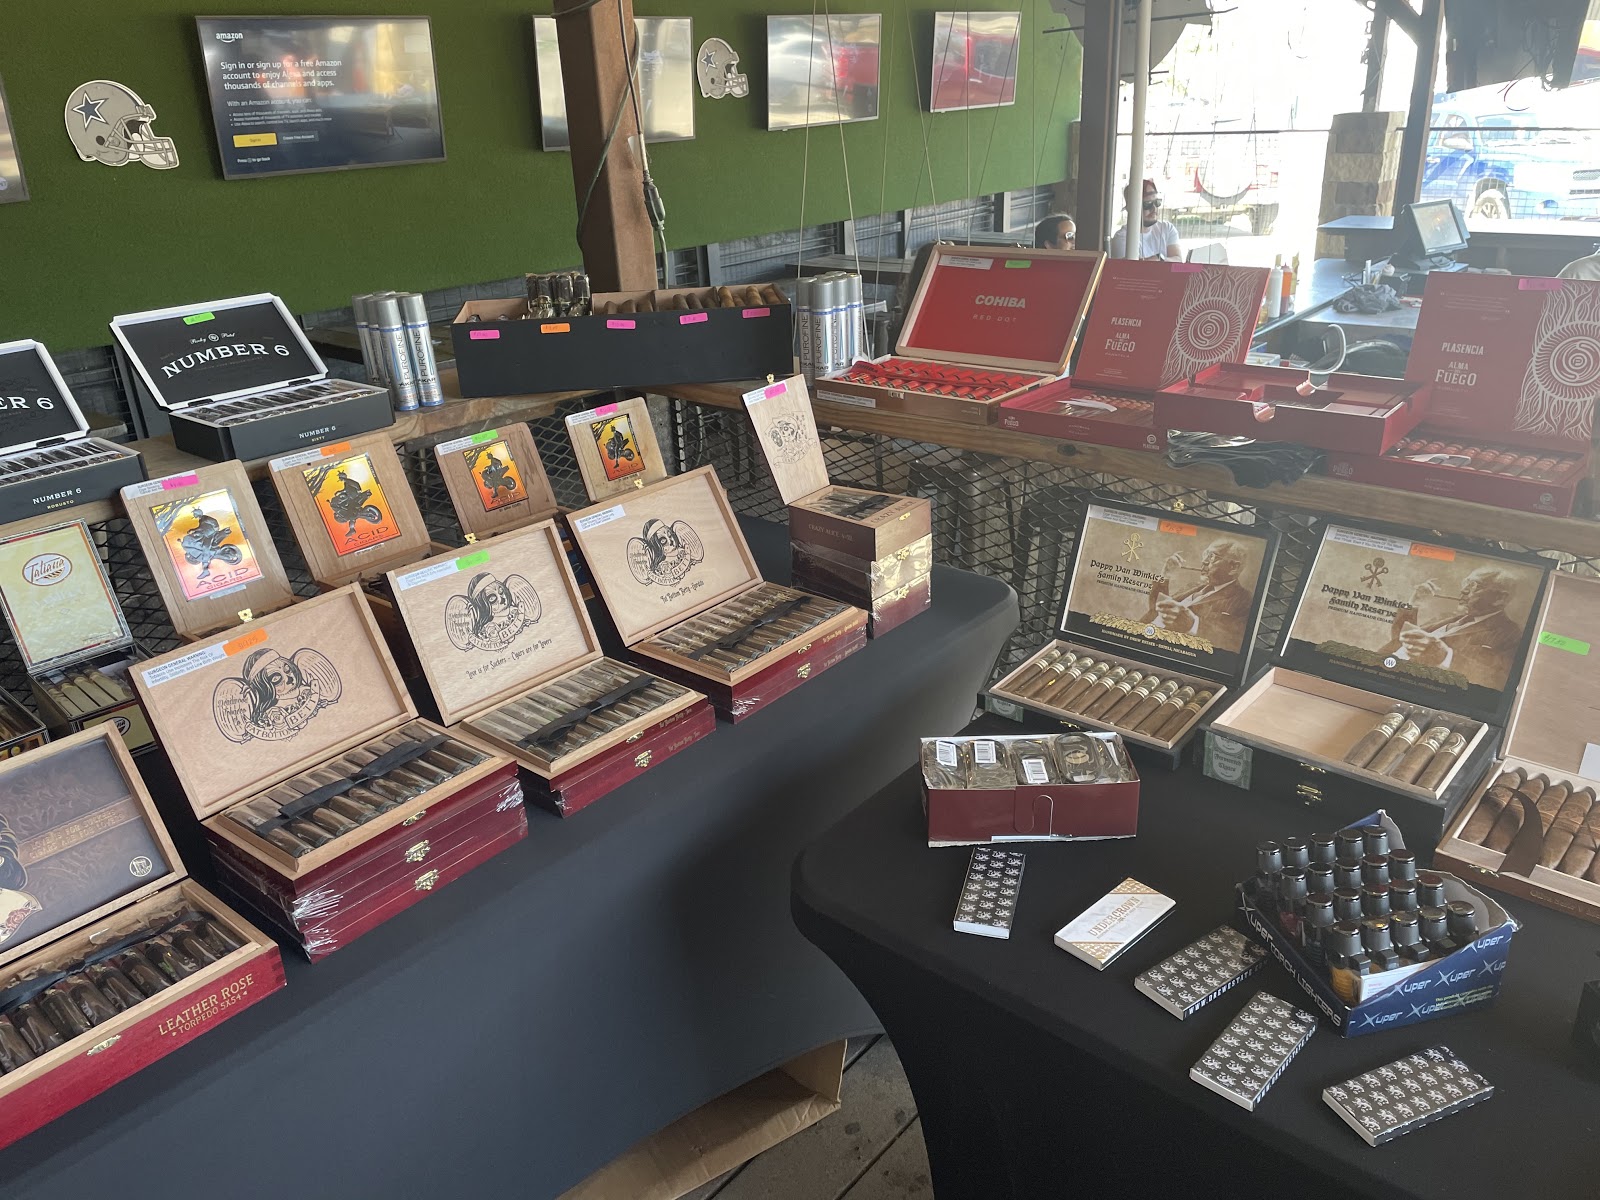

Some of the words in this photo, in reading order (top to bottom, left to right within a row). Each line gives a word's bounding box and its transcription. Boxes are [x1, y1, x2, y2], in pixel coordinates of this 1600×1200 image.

[216, 32, 243, 41] amazon
[220, 62, 237, 71] Sign
[239, 61, 245, 69] in
[256, 61, 270, 70] sign
[223, 72, 250, 80] account
[262, 71, 280, 80] enjoy
[224, 82, 261, 90] thousands
[262, 81, 270, 89] of
[271, 80, 301, 88] channels
[317, 80, 334, 88] apps.
[975, 295, 1026, 308] COHIBA
[1111, 317, 1142, 327] PLASENCIA
[802, 315, 810, 360] PUROFINE
[1115, 332, 1130, 340] ALMA
[414, 331, 428, 377] PUROFINE
[1105, 339, 1136, 352] FUEGO
[1441, 342, 1484, 355] PLASENCIA
[161, 344, 269, 379] NUMBER
[274, 345, 290, 356] 6
[396, 334, 410, 380] PUROFINE
[1448, 361, 1469, 370] ALMA
[1435, 369, 1477, 386] FUEGO
[37, 398, 54, 410] 6
[299, 427, 329, 439] NUMBER
[613, 462, 638, 474] ACID
[33, 490, 73, 504] NUMBER
[47, 500, 74, 510] ROBUSTO
[345, 526, 389, 545] ACID
[26, 557, 65, 582] Tatiana
[196, 568, 249, 588] ACID
[1090, 560, 1113, 571] Pappy
[1116, 565, 1130, 574] Van
[1133, 569, 1164, 583] Winkle's
[1097, 571, 1122, 584] Family
[1123, 577, 1153, 589] Reserve
[1321, 584, 1350, 598] Pappy
[1352, 590, 1372, 602] Van
[1374, 595, 1413, 610] Winkle's
[1327, 605, 1349, 614] PREMIUM
[1349, 610, 1376, 620] HANDMADE
[1329, 597, 1359, 610] Family
[1361, 603, 1398, 618] Reserve
[167, 657, 186, 668] GENERAL
[490, 657, 506, 669] Suckers
[511, 649, 525, 660] Cigars
[61, 836, 78, 846] ARE
[80, 828, 95, 838] FOR
[1088, 896, 1140, 937] UNDERCROWN
[1239, 892, 1273, 942] Xuper
[1270, 942, 1296, 978] TORCH
[1298, 973, 1341, 1027] LIGHTERS
[1388, 979, 1432, 997] Xuper
[1434, 968, 1476, 987] Xuper
[159, 994, 218, 1036] LEATHER
[221, 973, 254, 999] ROSE
[179, 1007, 218, 1034] TORPEDO
[1358, 1011, 1403, 1028] Xuper
